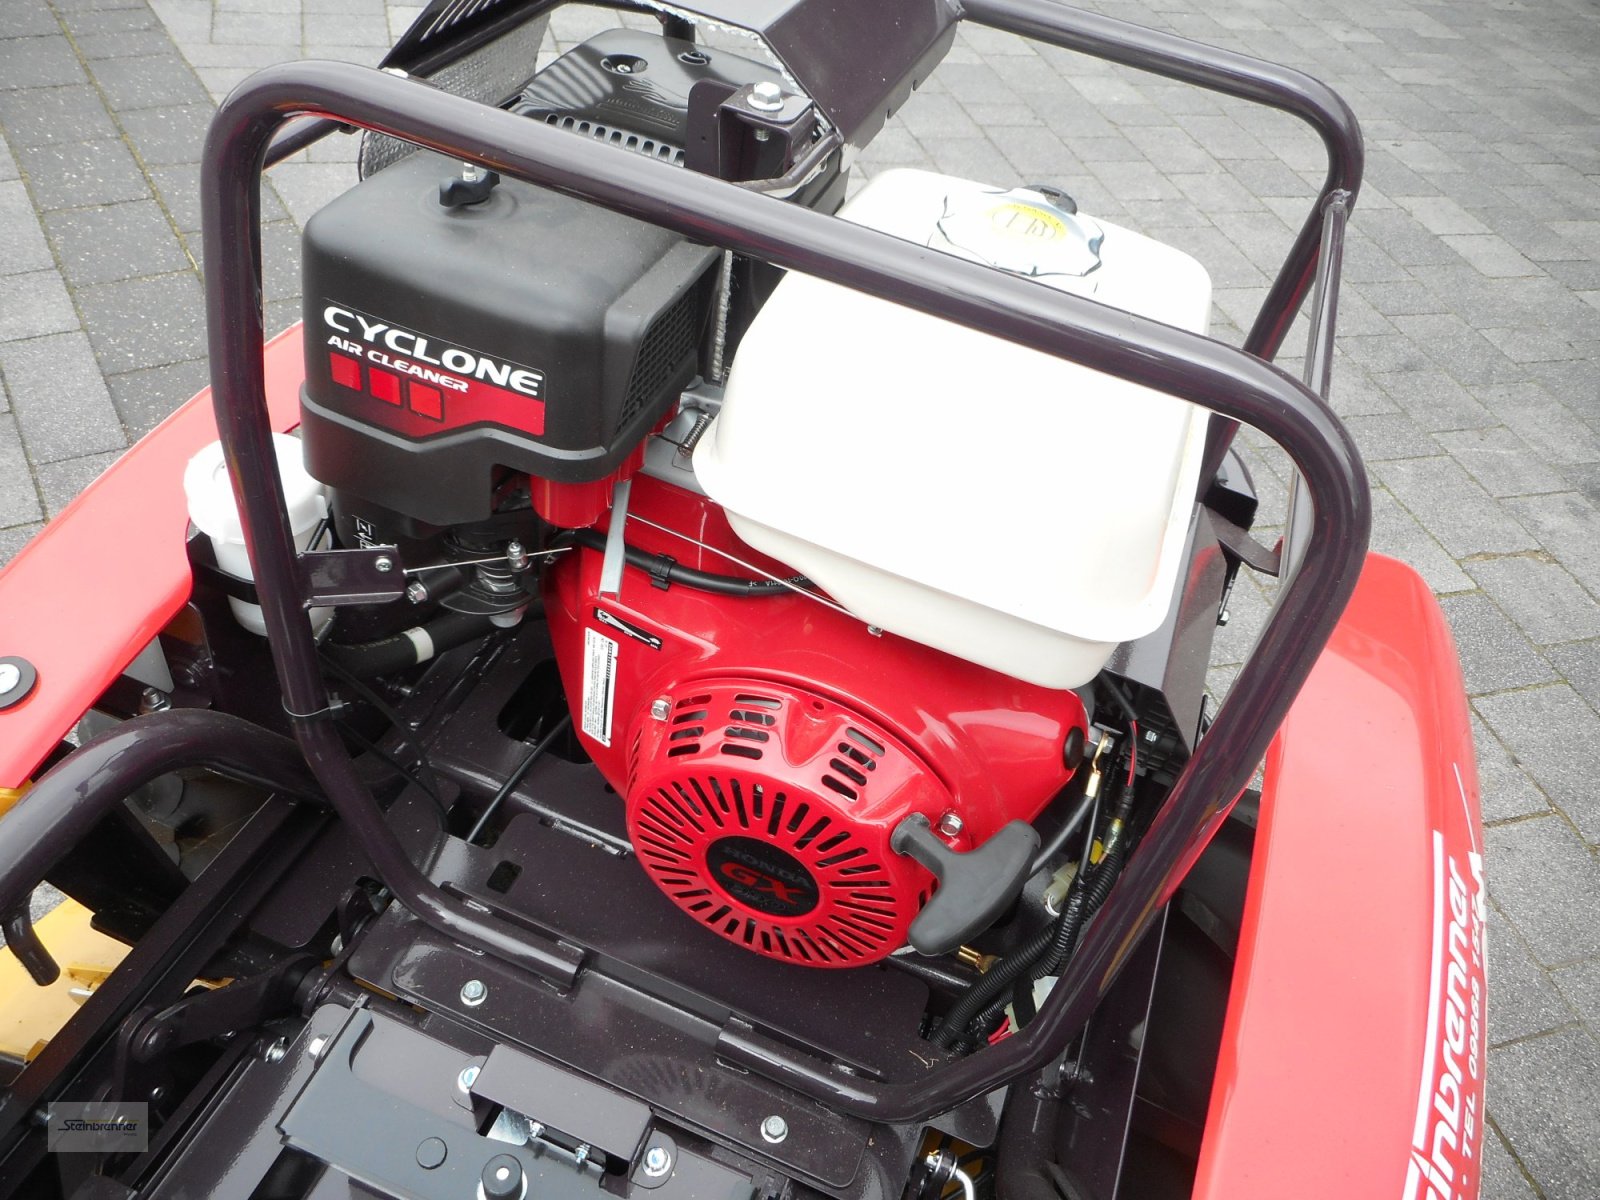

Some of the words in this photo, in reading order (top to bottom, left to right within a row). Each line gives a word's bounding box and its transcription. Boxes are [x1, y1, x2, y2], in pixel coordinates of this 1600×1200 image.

[323, 306, 543, 396] CYCLONE
[327, 335, 363, 357] AIR
[367, 351, 469, 393] CLEANER
[720, 861, 808, 905] GX
[722, 846, 813, 889] HONDA
[1468, 976, 1480, 1081] 09868
[1462, 1092, 1476, 1159] TEL
